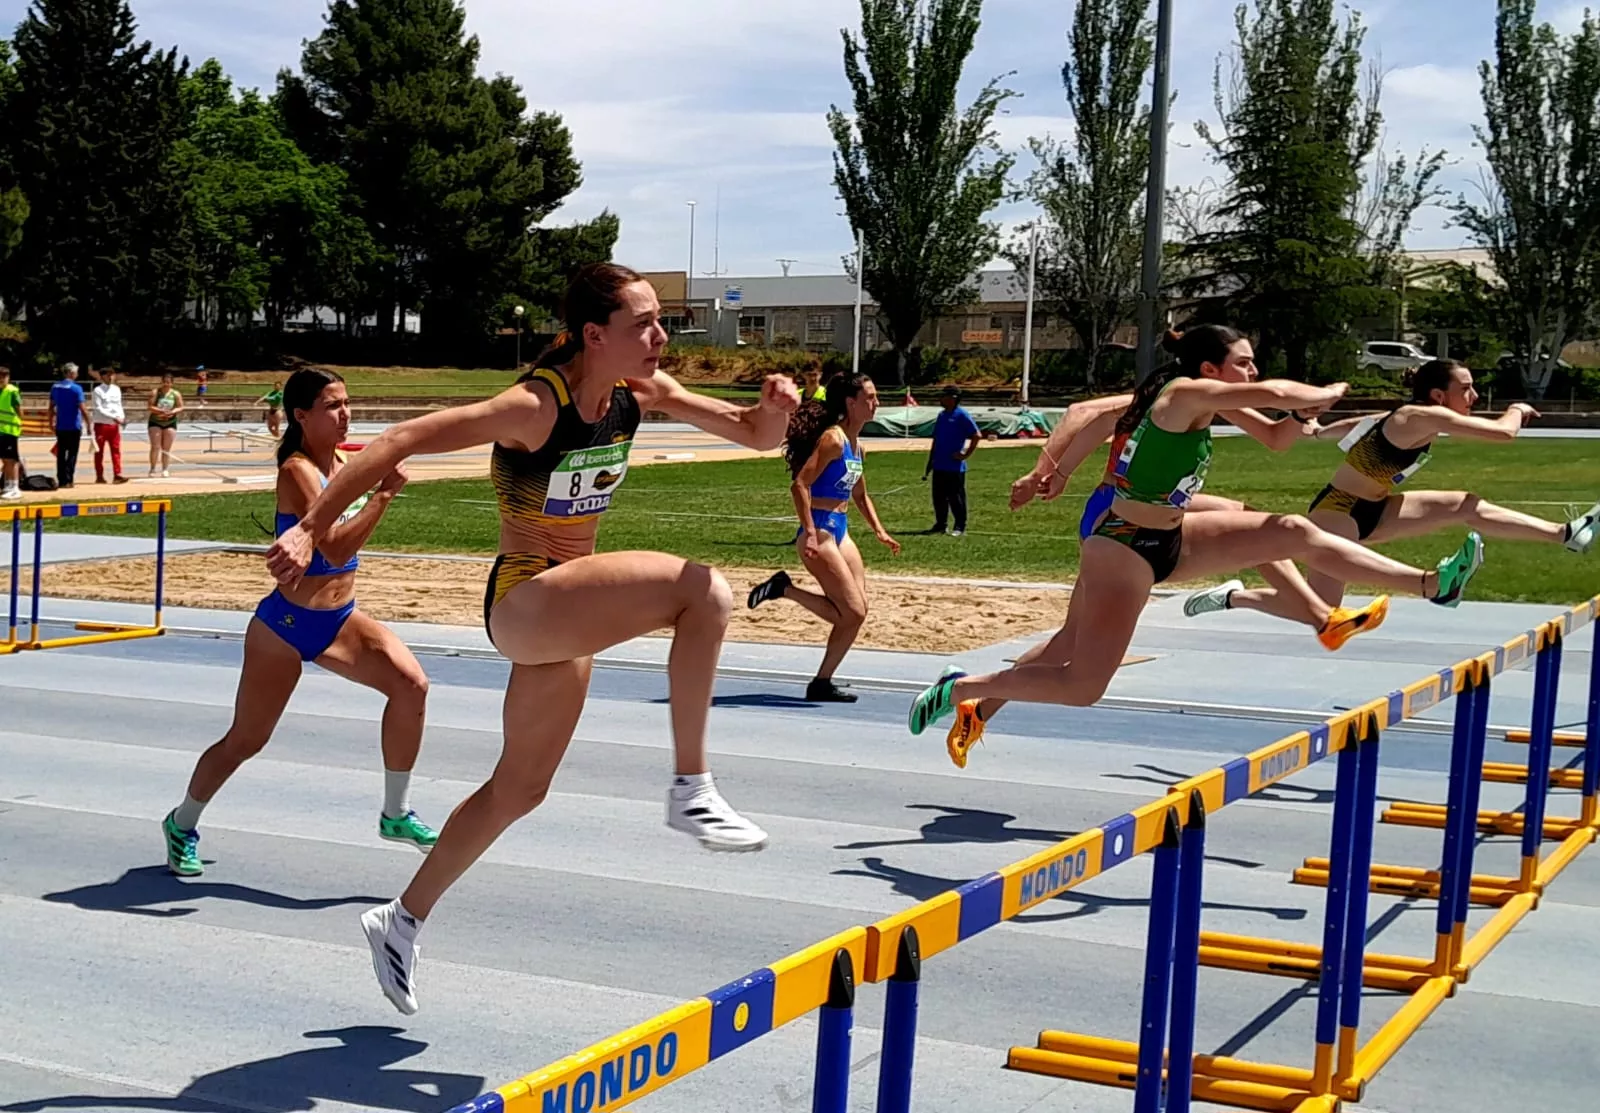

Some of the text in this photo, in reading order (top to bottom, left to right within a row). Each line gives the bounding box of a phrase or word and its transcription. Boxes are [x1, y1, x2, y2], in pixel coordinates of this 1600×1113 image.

[569, 472, 582, 498] 8
[568, 495, 610, 514] Joma
[1260, 744, 1300, 781] MONDO
[1019, 847, 1088, 906] MONDO
[541, 1031, 679, 1113] MONDO
